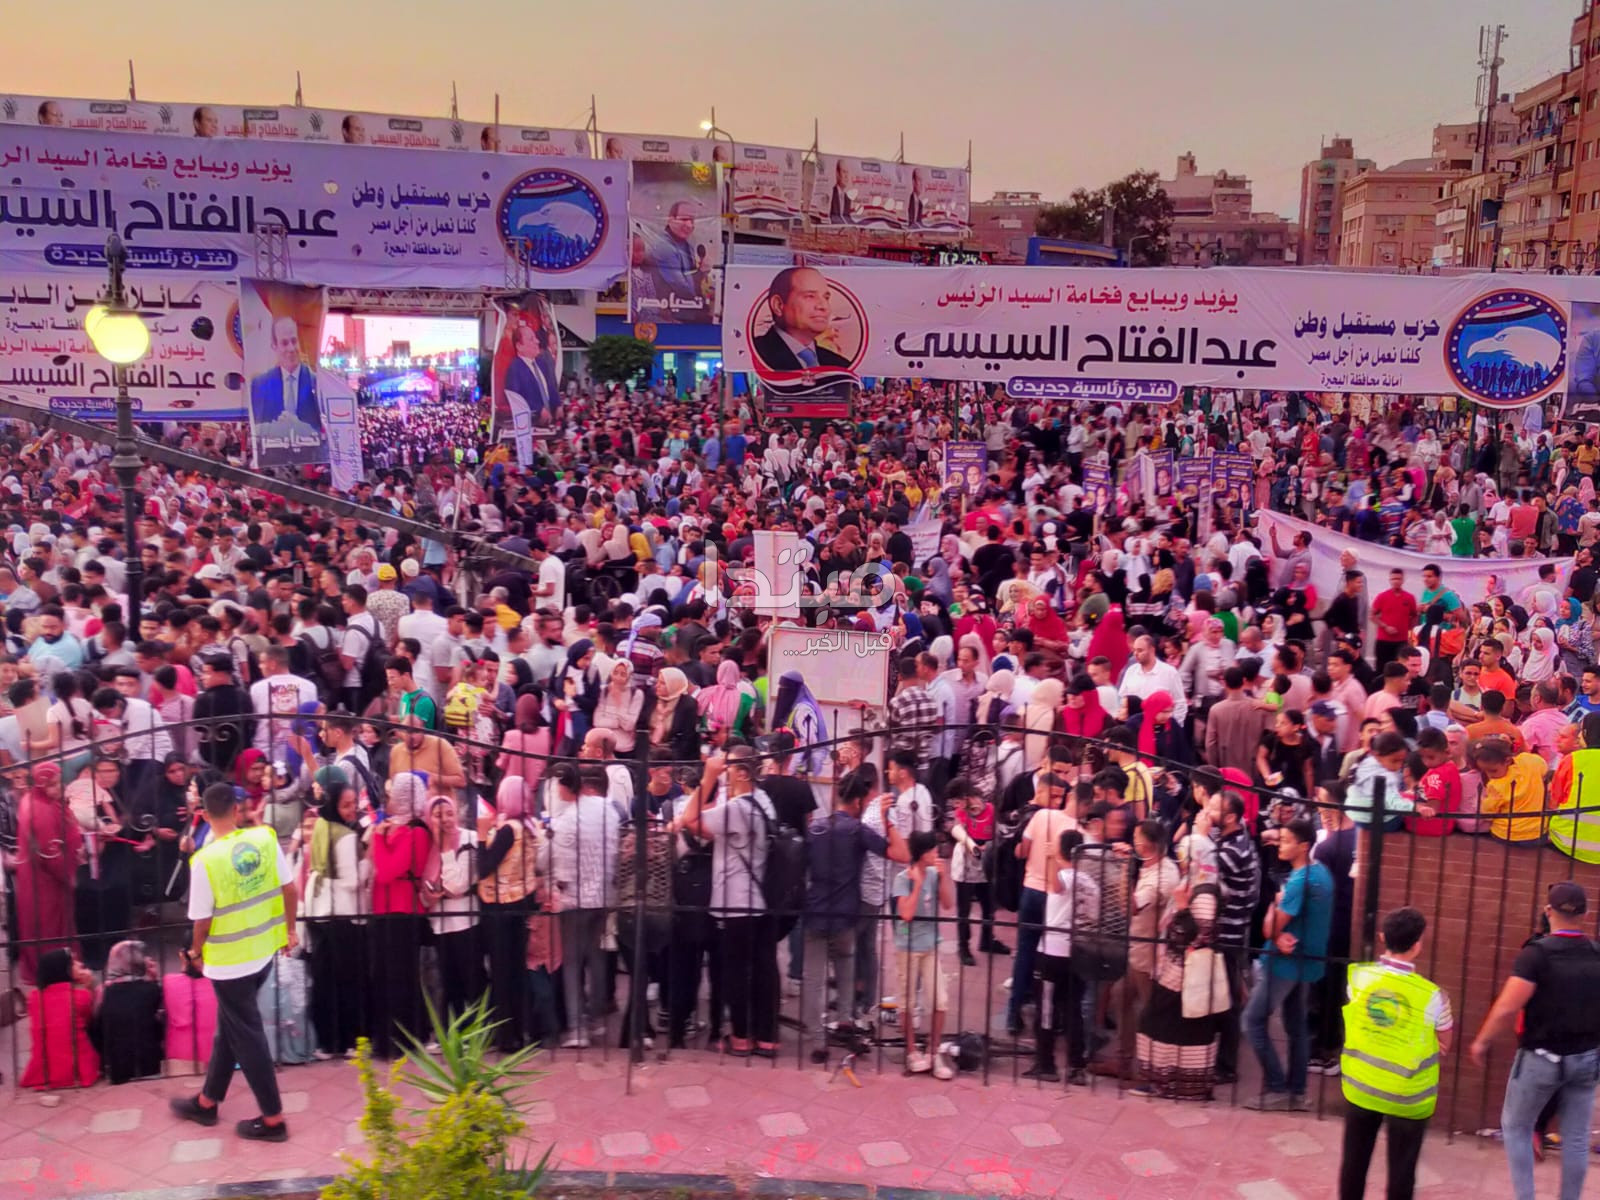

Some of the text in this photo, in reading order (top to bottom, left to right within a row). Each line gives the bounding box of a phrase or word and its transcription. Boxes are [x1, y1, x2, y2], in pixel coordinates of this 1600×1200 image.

[37, 148, 98, 172] السيد
[104, 147, 168, 170] فخامة
[173, 154, 240, 180] ويبايع
[245, 158, 292, 184] يؤيد
[352, 180, 491, 213] حزب مستقبل وطن
[368, 213, 477, 236] كلنا نعمل من أجل مصر
[50, 245, 233, 269] لفترة رئاسي ديدة
[383, 241, 411, 258] البحيرة
[412, 241, 442, 256] محافظة
[936, 284, 1239, 314] يؤيد ويبايع فخامة السيد الرئيس
[5, 318, 48, 335] البحيرة
[1293, 309, 1441, 342] حزب مستقبل وطن
[31, 338, 67, 357] السيد
[893, 324, 1070, 371] السيسي
[1307, 342, 1422, 368] كلنا نعمل من أجل مصر
[1011, 378, 1173, 399] لفترة رئاسية جديدة
[1320, 372, 1349, 388] البحيرة
[1349, 372, 1381, 387] محافظة
[51, 398, 84, 410] جديدة
[261, 428, 320, 455] تحيا مصر
